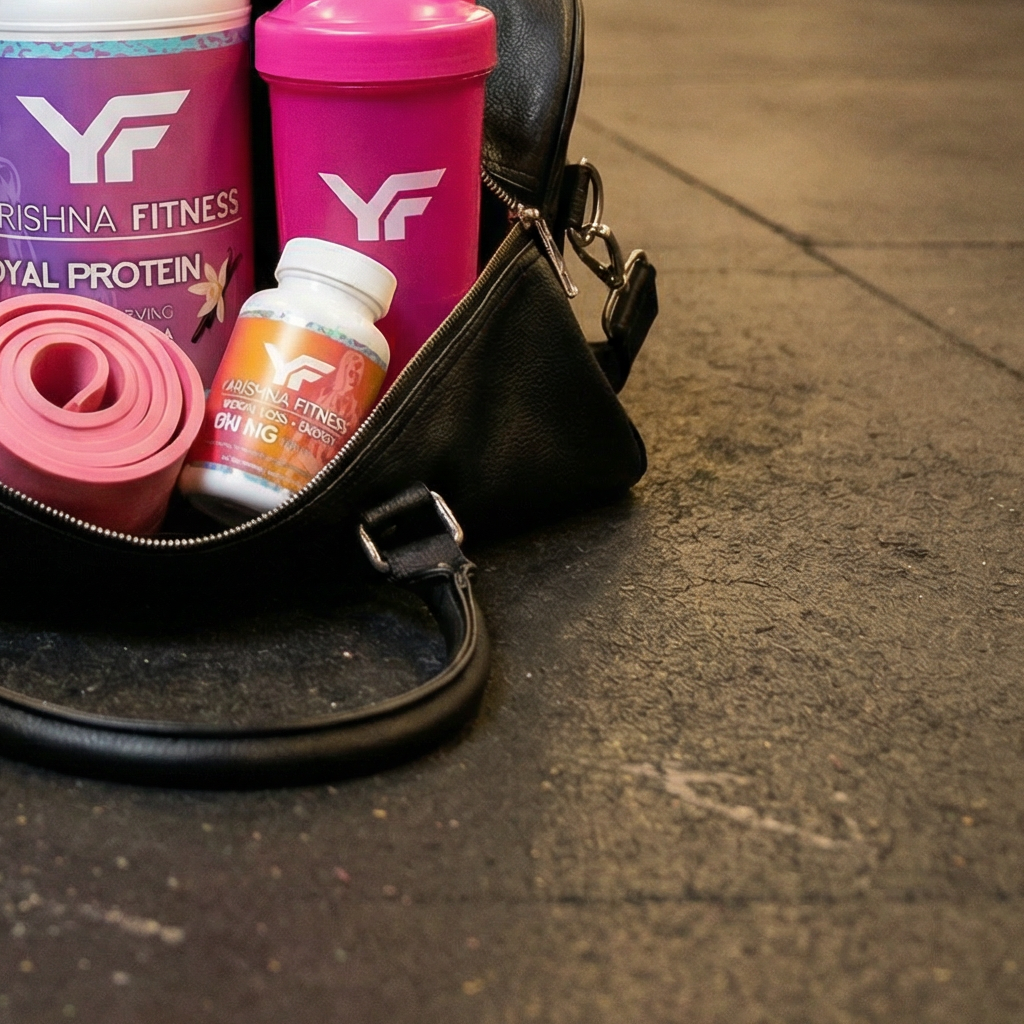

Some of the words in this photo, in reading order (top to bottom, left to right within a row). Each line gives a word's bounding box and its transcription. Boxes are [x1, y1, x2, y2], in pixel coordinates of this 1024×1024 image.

[16, 89, 191, 184] YF
[132, 188, 240, 232] FITNESS
[318, 167, 447, 242] YF
[68, 253, 202, 289] PROTEIN
